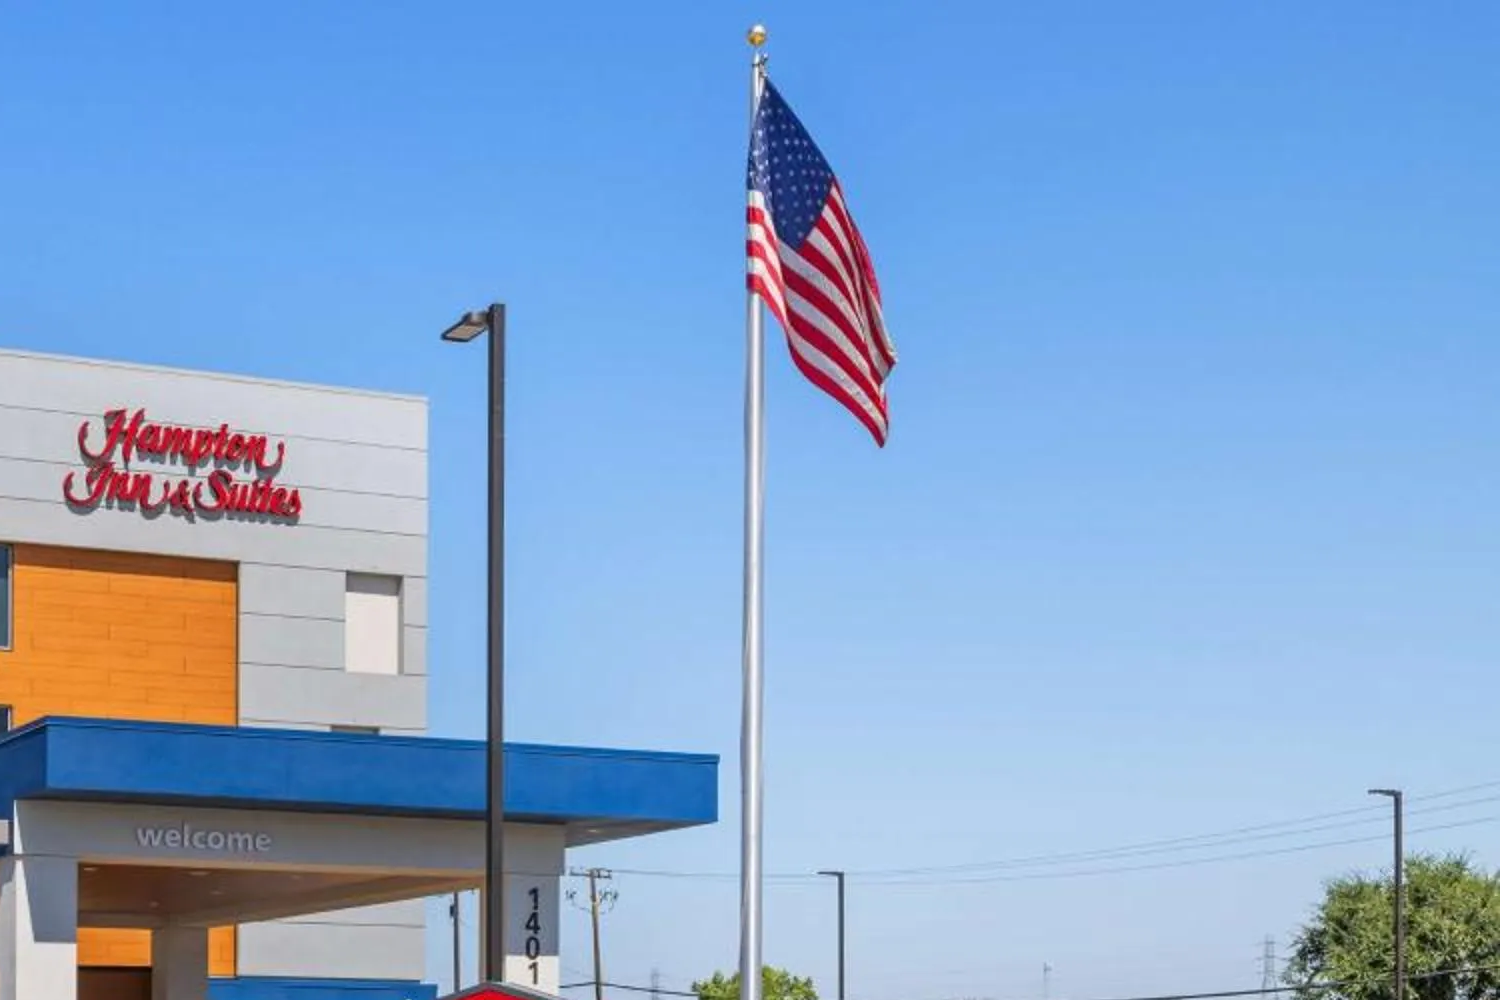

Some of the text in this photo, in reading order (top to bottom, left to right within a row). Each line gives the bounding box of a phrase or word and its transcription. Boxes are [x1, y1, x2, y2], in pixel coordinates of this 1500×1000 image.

[78, 408, 286, 471] Hampton
[63, 461, 303, 516] Inn & Suites
[136, 822, 272, 851] welcome
[524, 886, 541, 985] 1401
